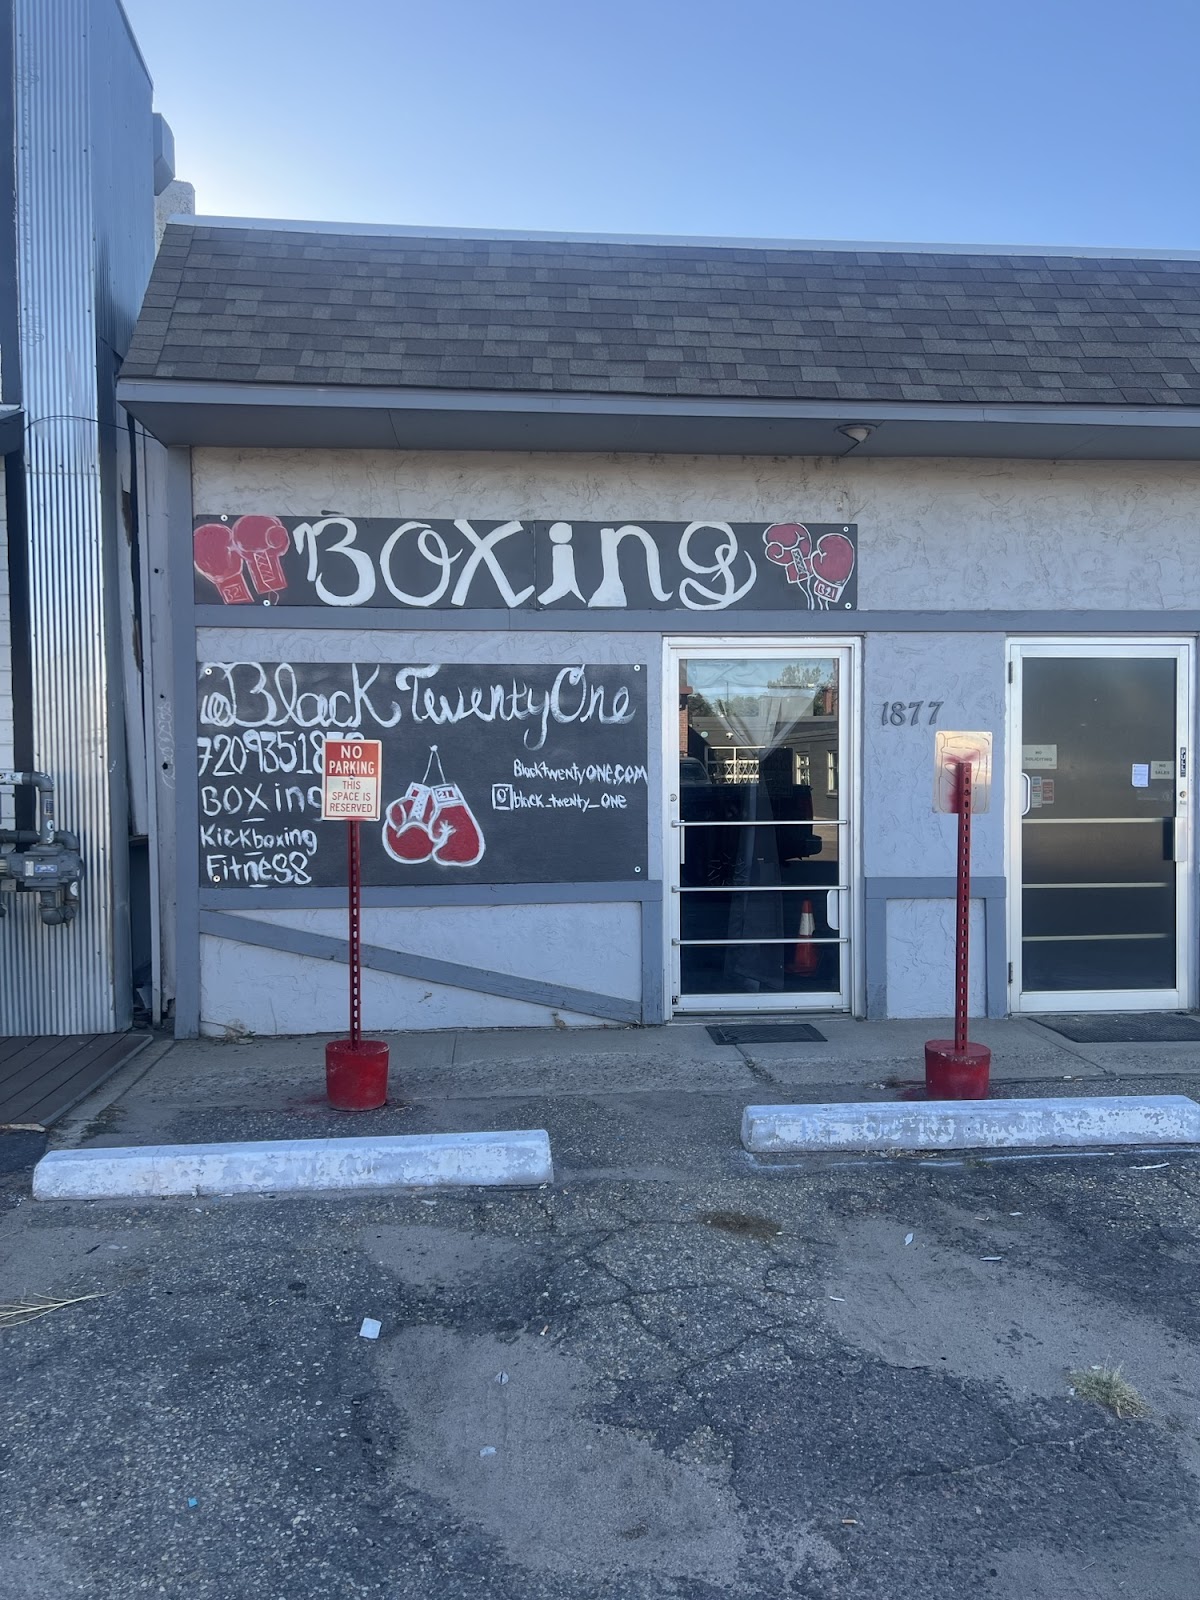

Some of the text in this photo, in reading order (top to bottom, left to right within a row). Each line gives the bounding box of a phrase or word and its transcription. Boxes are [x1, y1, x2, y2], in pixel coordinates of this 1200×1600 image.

[881, 700, 944, 726] 1877
[340, 745, 363, 759] NO
[328, 760, 375, 774] PARKING
[342, 780, 361, 790] THIS
[331, 791, 371, 801] SPACE IS
[329, 802, 373, 813] RESERVED
